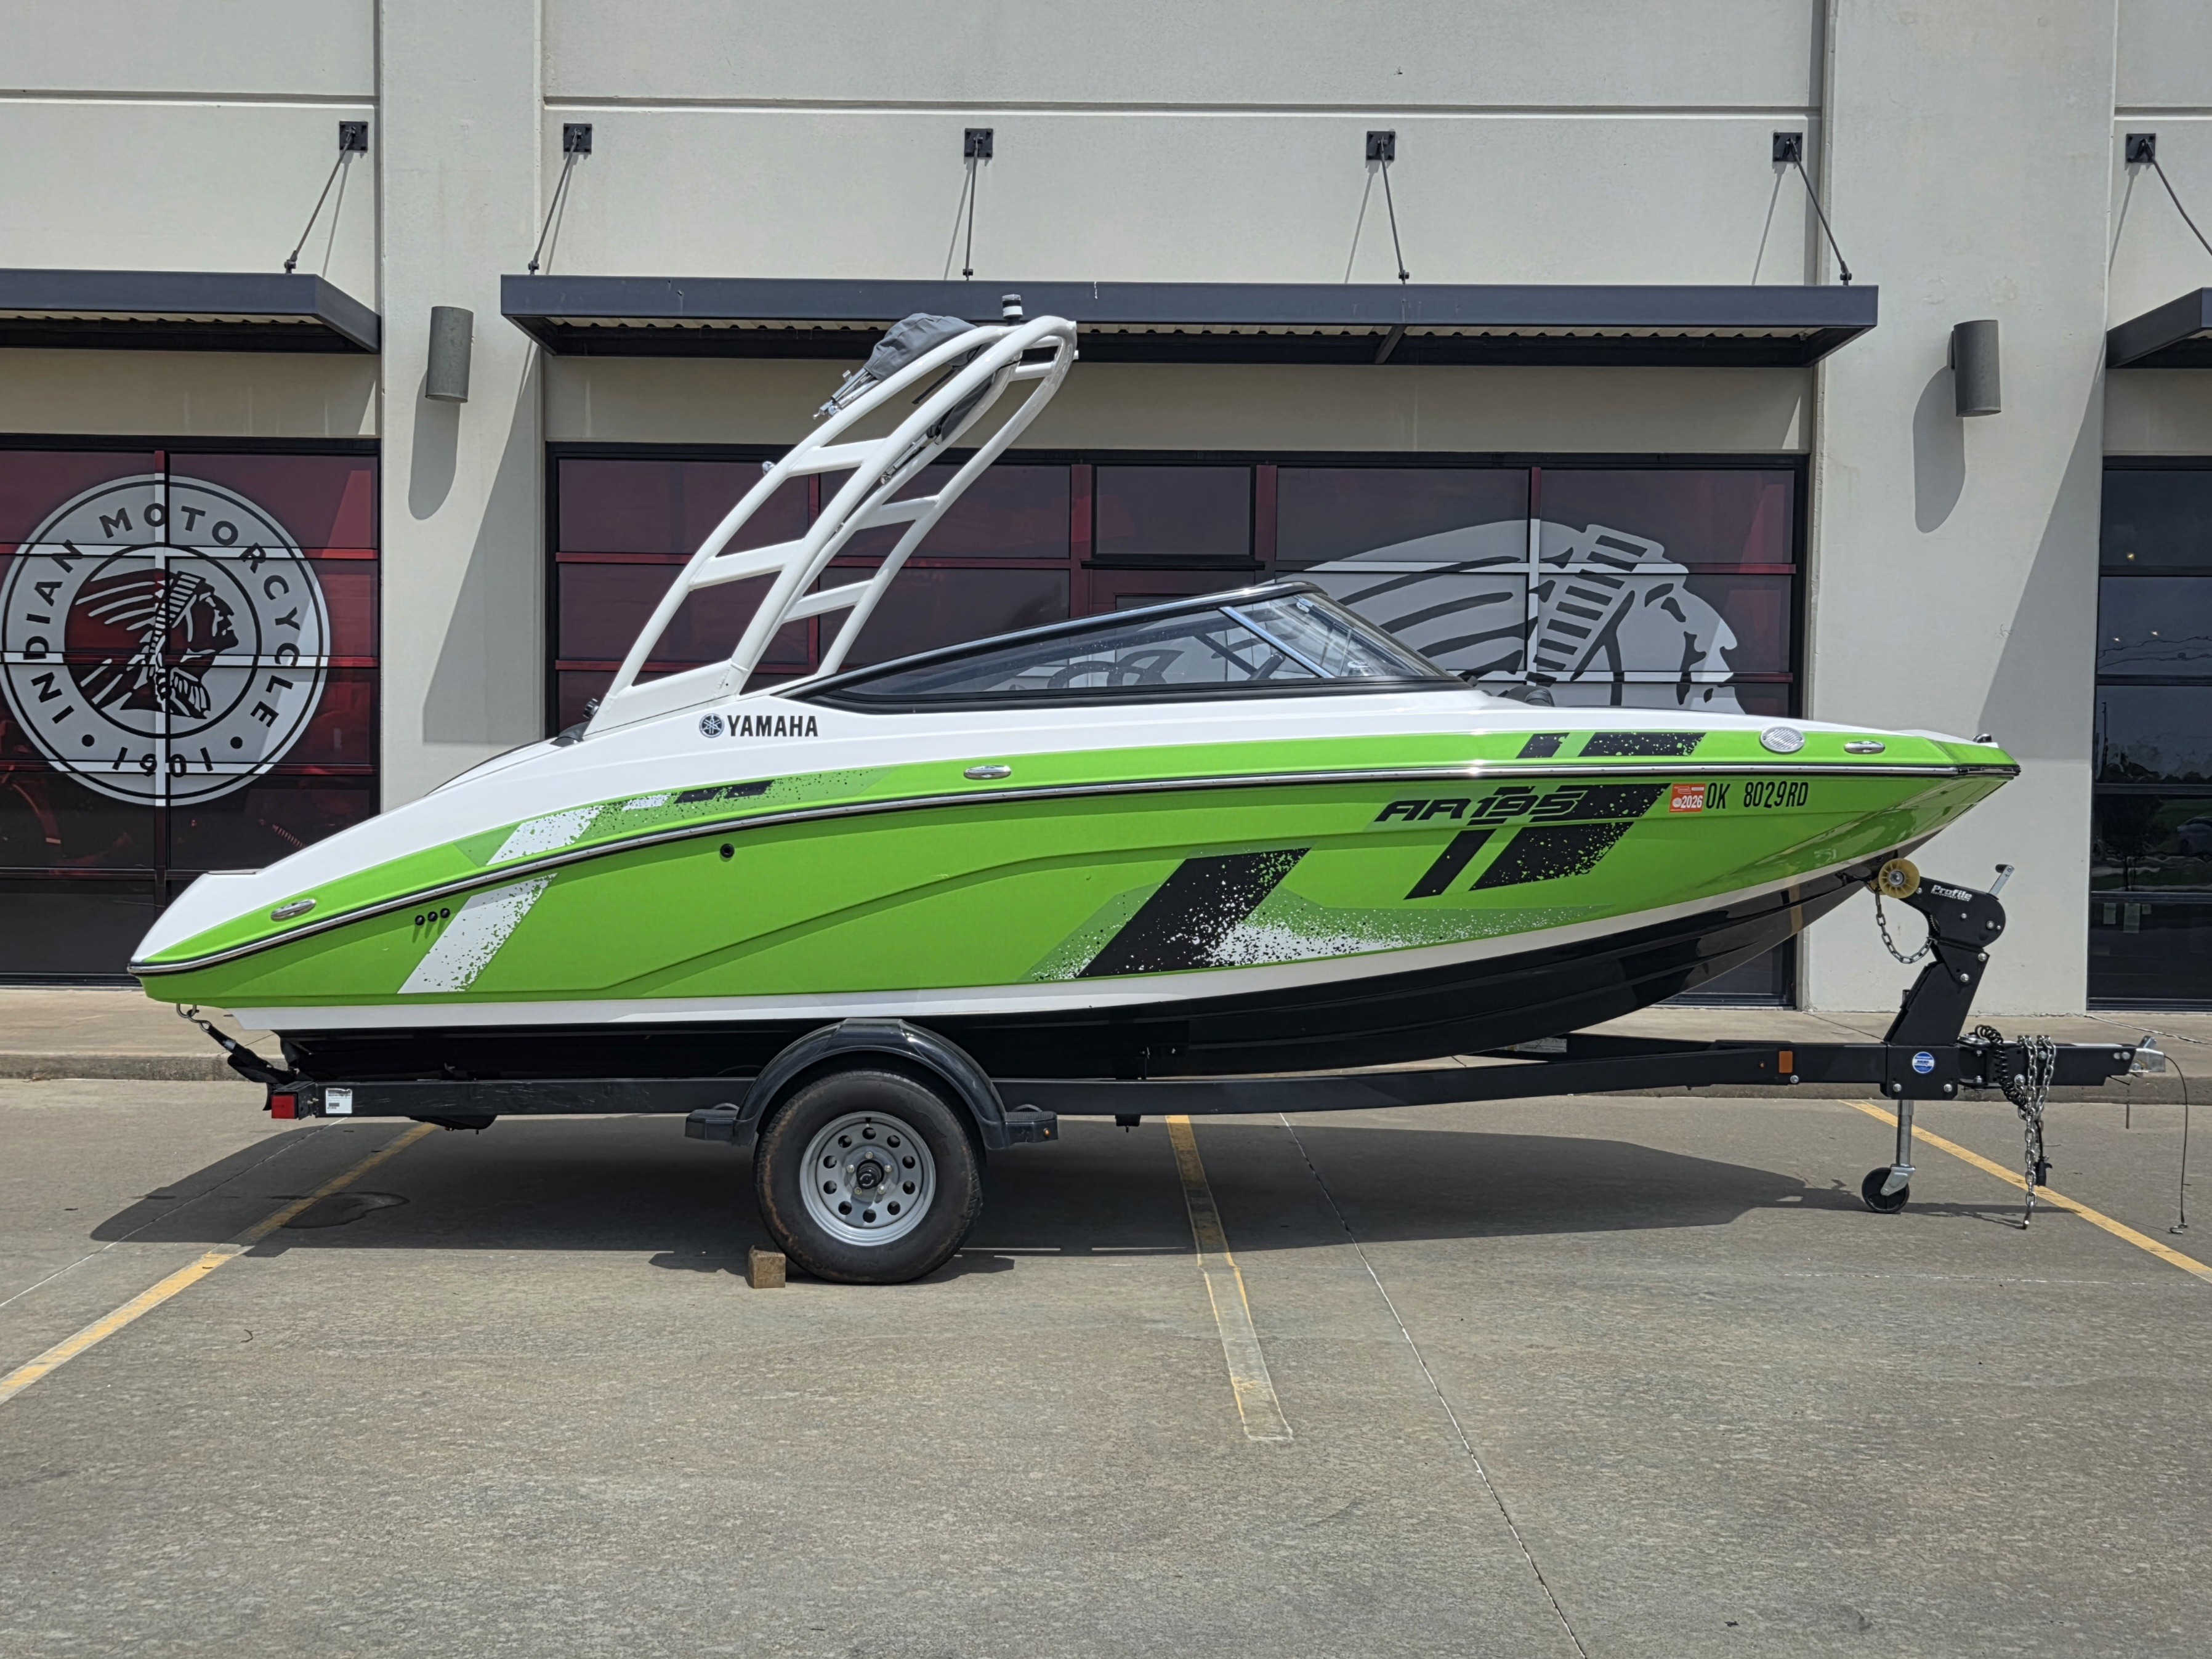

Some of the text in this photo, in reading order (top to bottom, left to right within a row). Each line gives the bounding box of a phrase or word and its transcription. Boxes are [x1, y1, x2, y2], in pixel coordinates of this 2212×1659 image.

[23, 503, 301, 728] INDIAN MOTORCYCLE
[727, 715, 818, 737] YAMAHA
[112, 746, 214, 777] 1901
[1374, 789, 1589, 822] AR195
[1681, 795, 1703, 809] 2026
[1706, 781, 1809, 809] OK 8029RD
[1931, 884, 1972, 900] Profile
